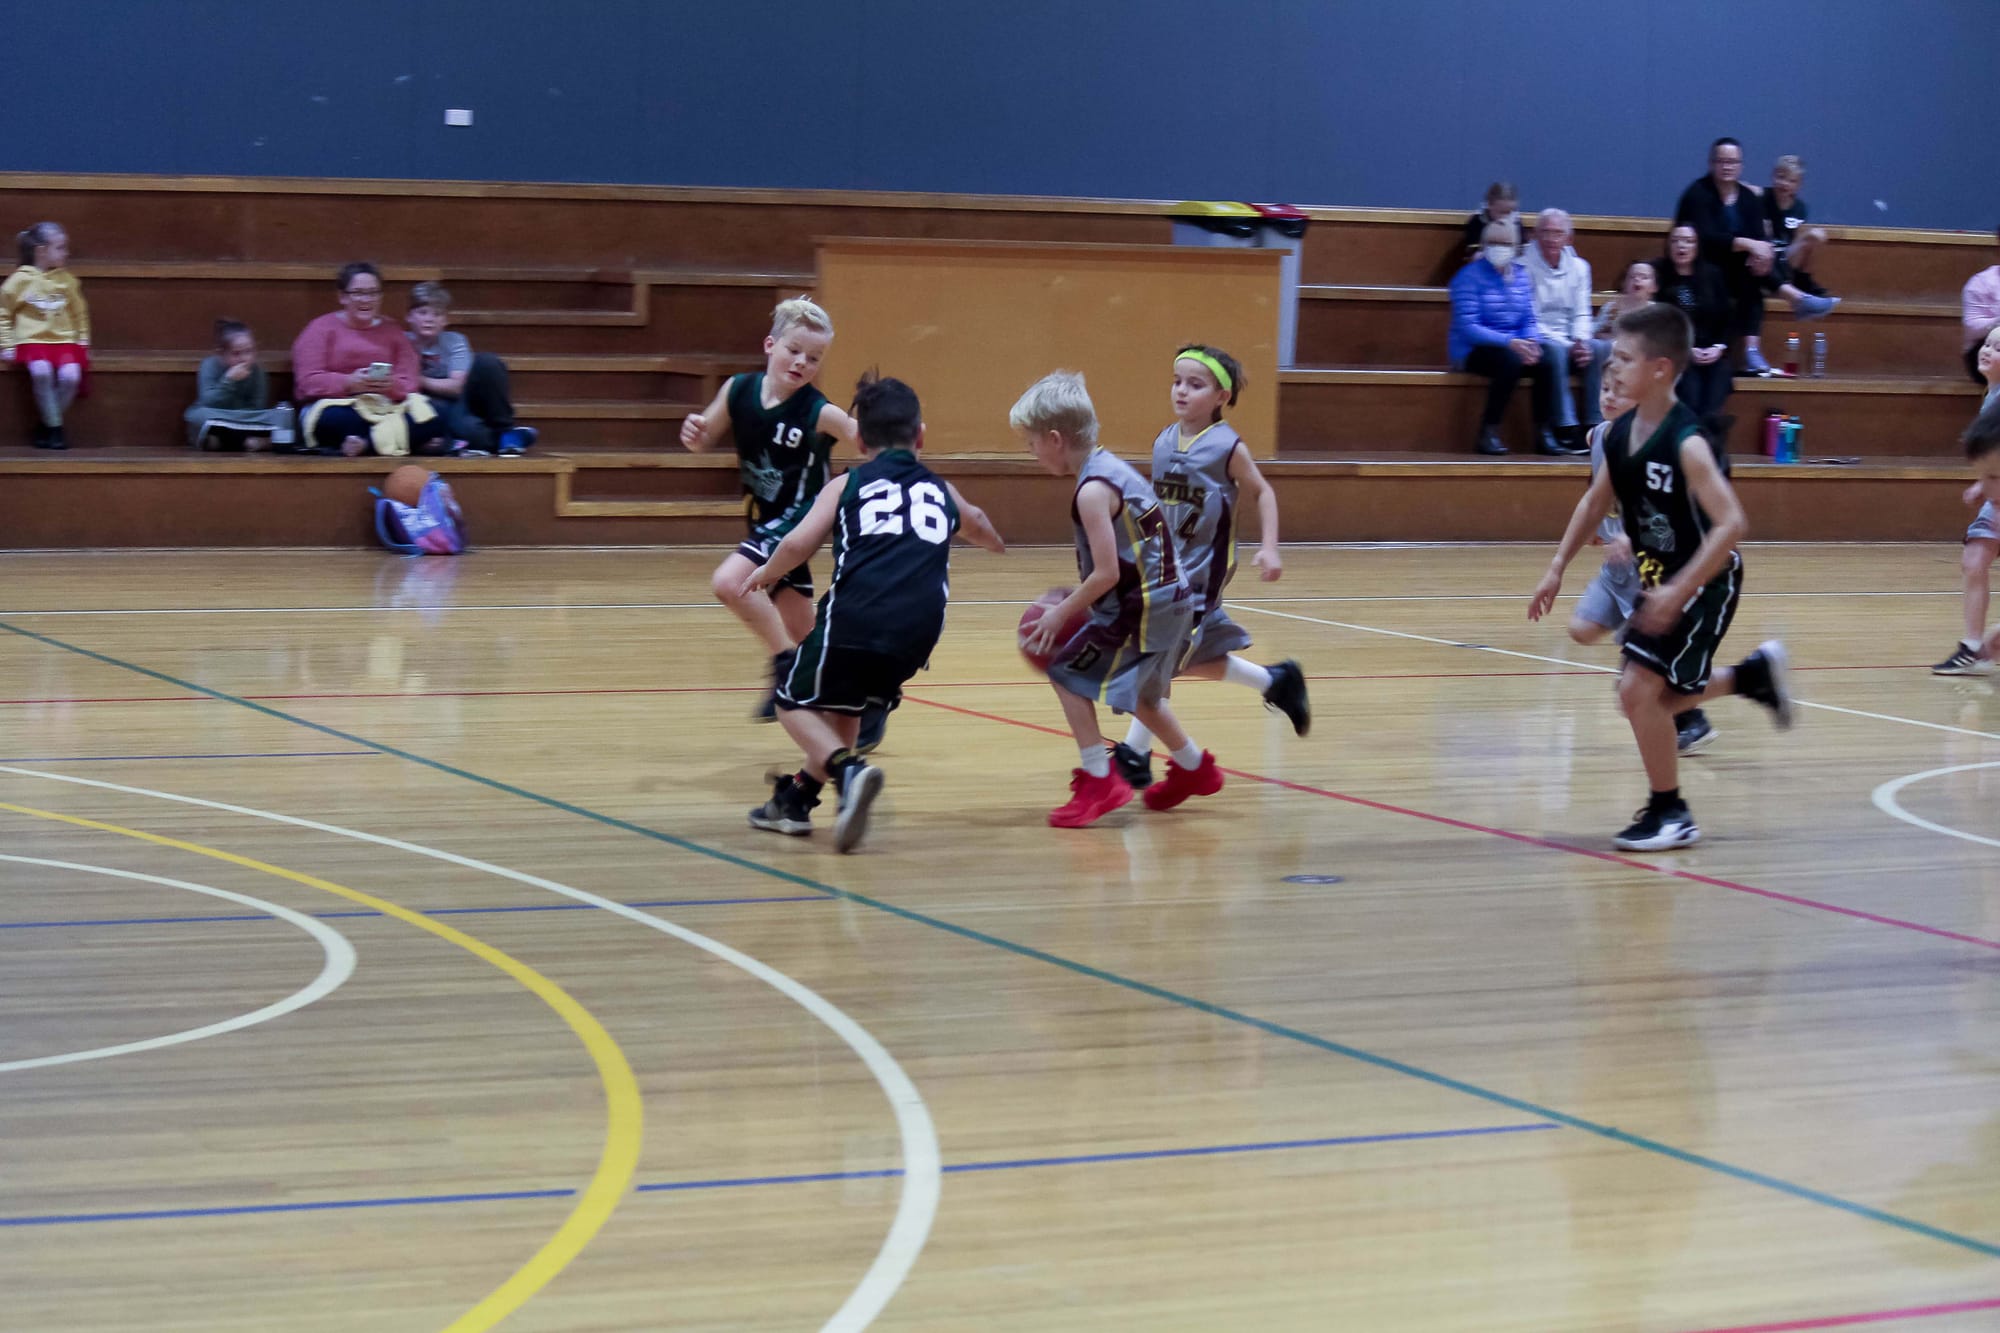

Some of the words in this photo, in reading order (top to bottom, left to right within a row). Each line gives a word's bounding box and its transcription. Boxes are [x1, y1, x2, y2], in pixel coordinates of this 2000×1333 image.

[772, 422, 803, 449] 19
[858, 478, 948, 545] 26
[1176, 511, 1200, 544] 4
